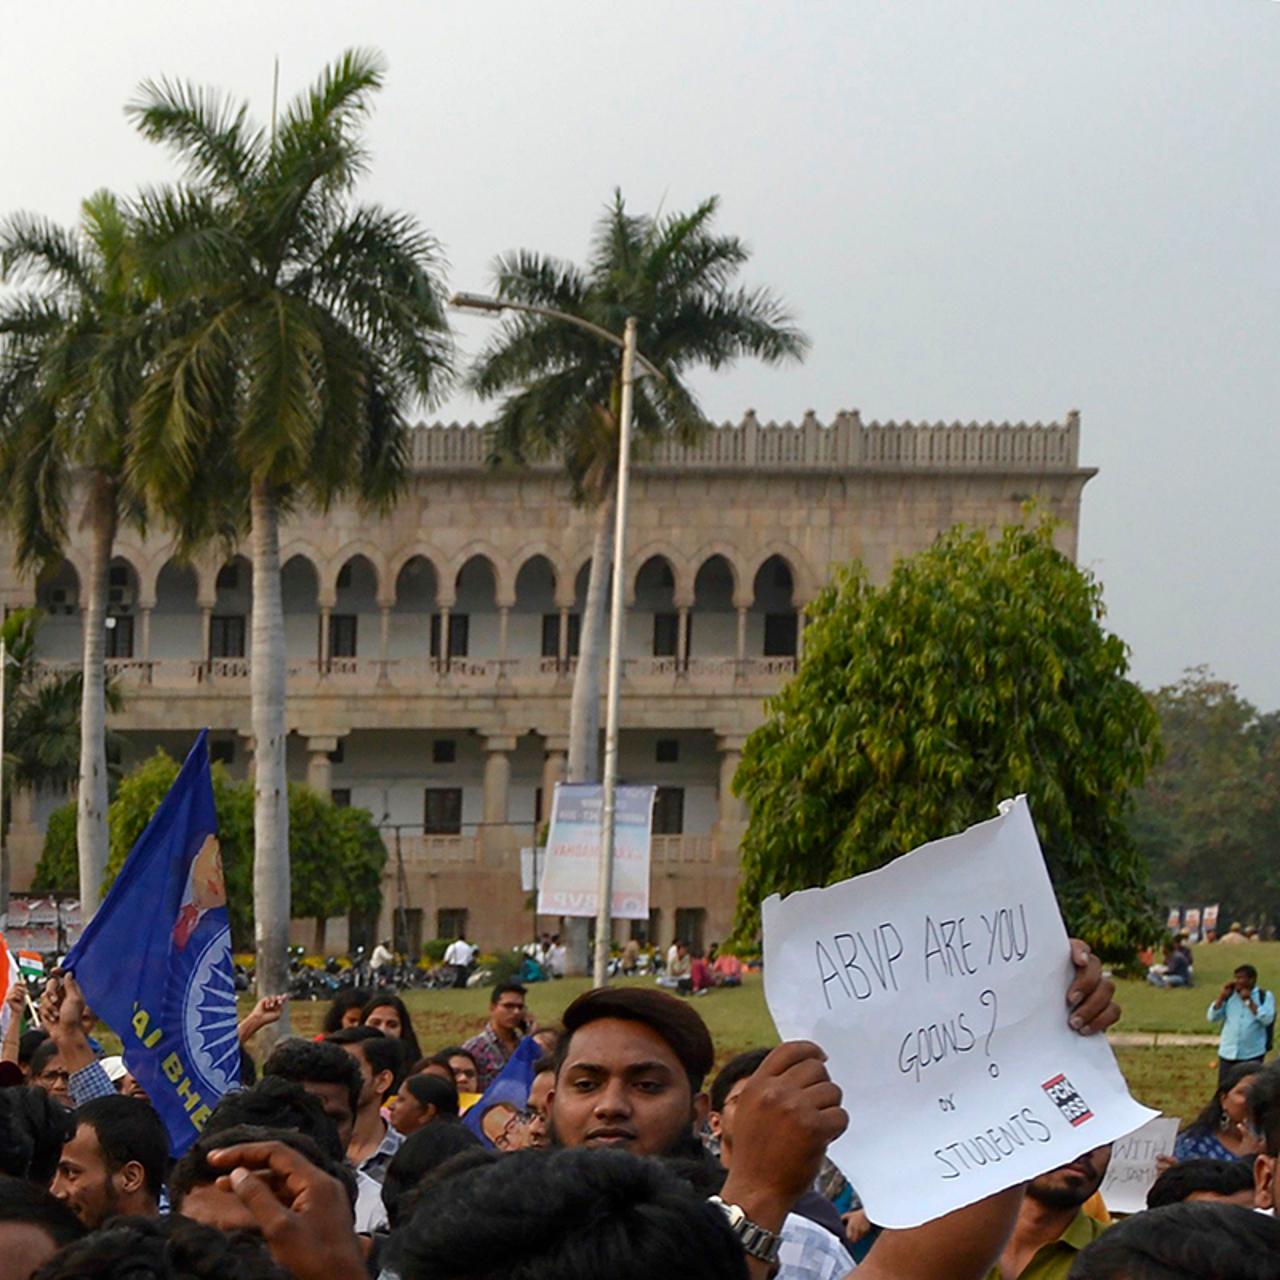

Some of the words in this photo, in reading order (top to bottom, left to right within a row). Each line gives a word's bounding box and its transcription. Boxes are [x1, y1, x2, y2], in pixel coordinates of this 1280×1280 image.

[815, 922, 904, 1010] ABVP
[924, 915, 978, 982] ARE
[980, 904, 1029, 965] YOU
[132, 1001, 163, 1049] AI
[933, 1107, 1052, 1180] STUDENTS
